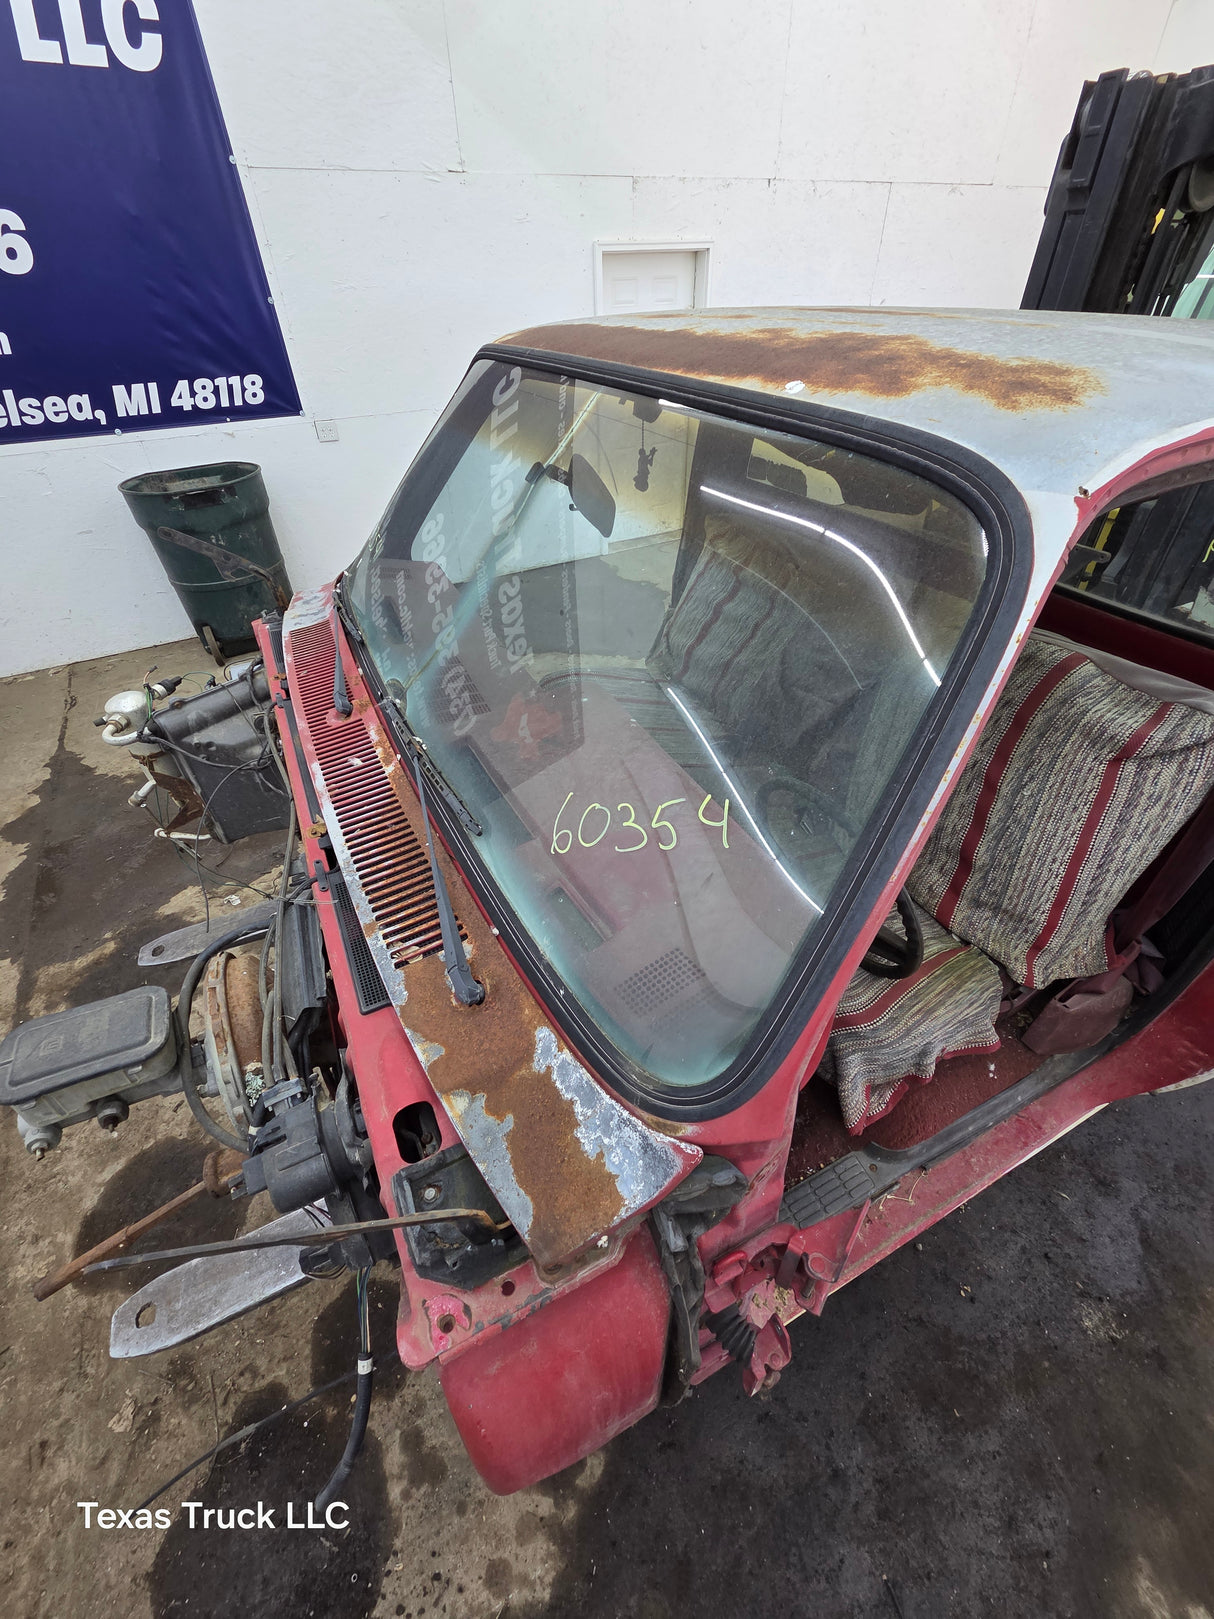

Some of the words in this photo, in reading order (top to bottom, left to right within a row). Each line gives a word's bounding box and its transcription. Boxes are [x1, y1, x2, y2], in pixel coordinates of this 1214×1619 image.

[10, 0, 163, 72] LLC
[112, 382, 161, 418] MI
[170, 374, 265, 412] 48118
[551, 792, 730, 854] 60354
